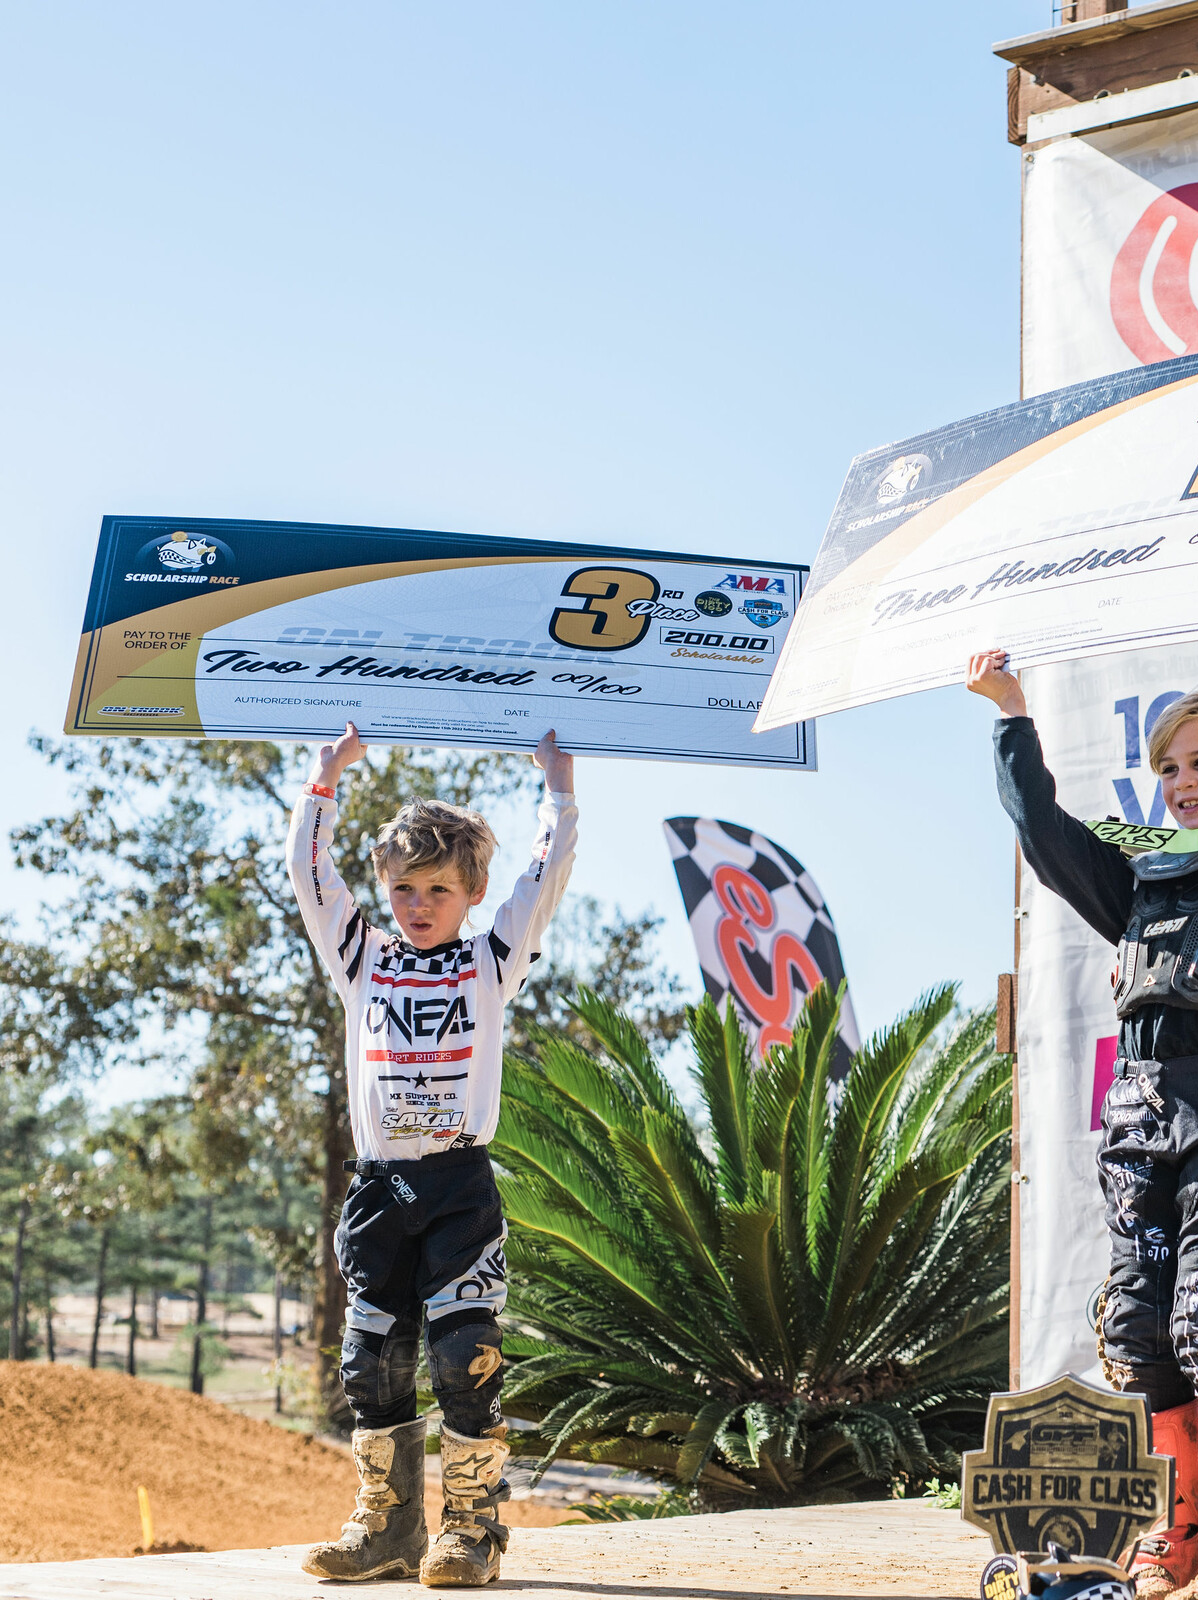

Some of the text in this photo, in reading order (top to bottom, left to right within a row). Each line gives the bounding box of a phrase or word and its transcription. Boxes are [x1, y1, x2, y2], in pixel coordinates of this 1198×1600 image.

[846, 504, 906, 533] SCHOLARSHIP
[124, 573, 240, 584] SCHOLARSHIP RACE
[714, 574, 786, 594] AMA
[872, 584, 968, 627] Three
[975, 536, 1165, 593] Hundred
[548, 566, 684, 652] 3 RD
[625, 599, 700, 623] Place
[696, 598, 731, 610] DIRTY
[1098, 597, 1123, 609] DATE
[771, 609, 789, 619] CLASS
[123, 630, 191, 640] PAY TO THE
[664, 630, 770, 651] 200.00
[124, 640, 188, 650] ORDER OF
[671, 648, 765, 664] Scholarship
[203, 650, 310, 673] Two
[315, 655, 539, 687] Hundred
[551, 672, 642, 696] 00/100
[234, 696, 530, 718] AUTHORIZED SIGNATURE DATE
[415, 1052, 452, 1061] RIDERS
[390, 1092, 458, 1101] MX SUPPLY CO.
[381, 1111, 464, 1130] SAKAI
[1040, 1474, 1081, 1500] FOR
[1089, 1475, 1157, 1511] CLASS
[984, 1571, 1020, 1600] DIRTY
